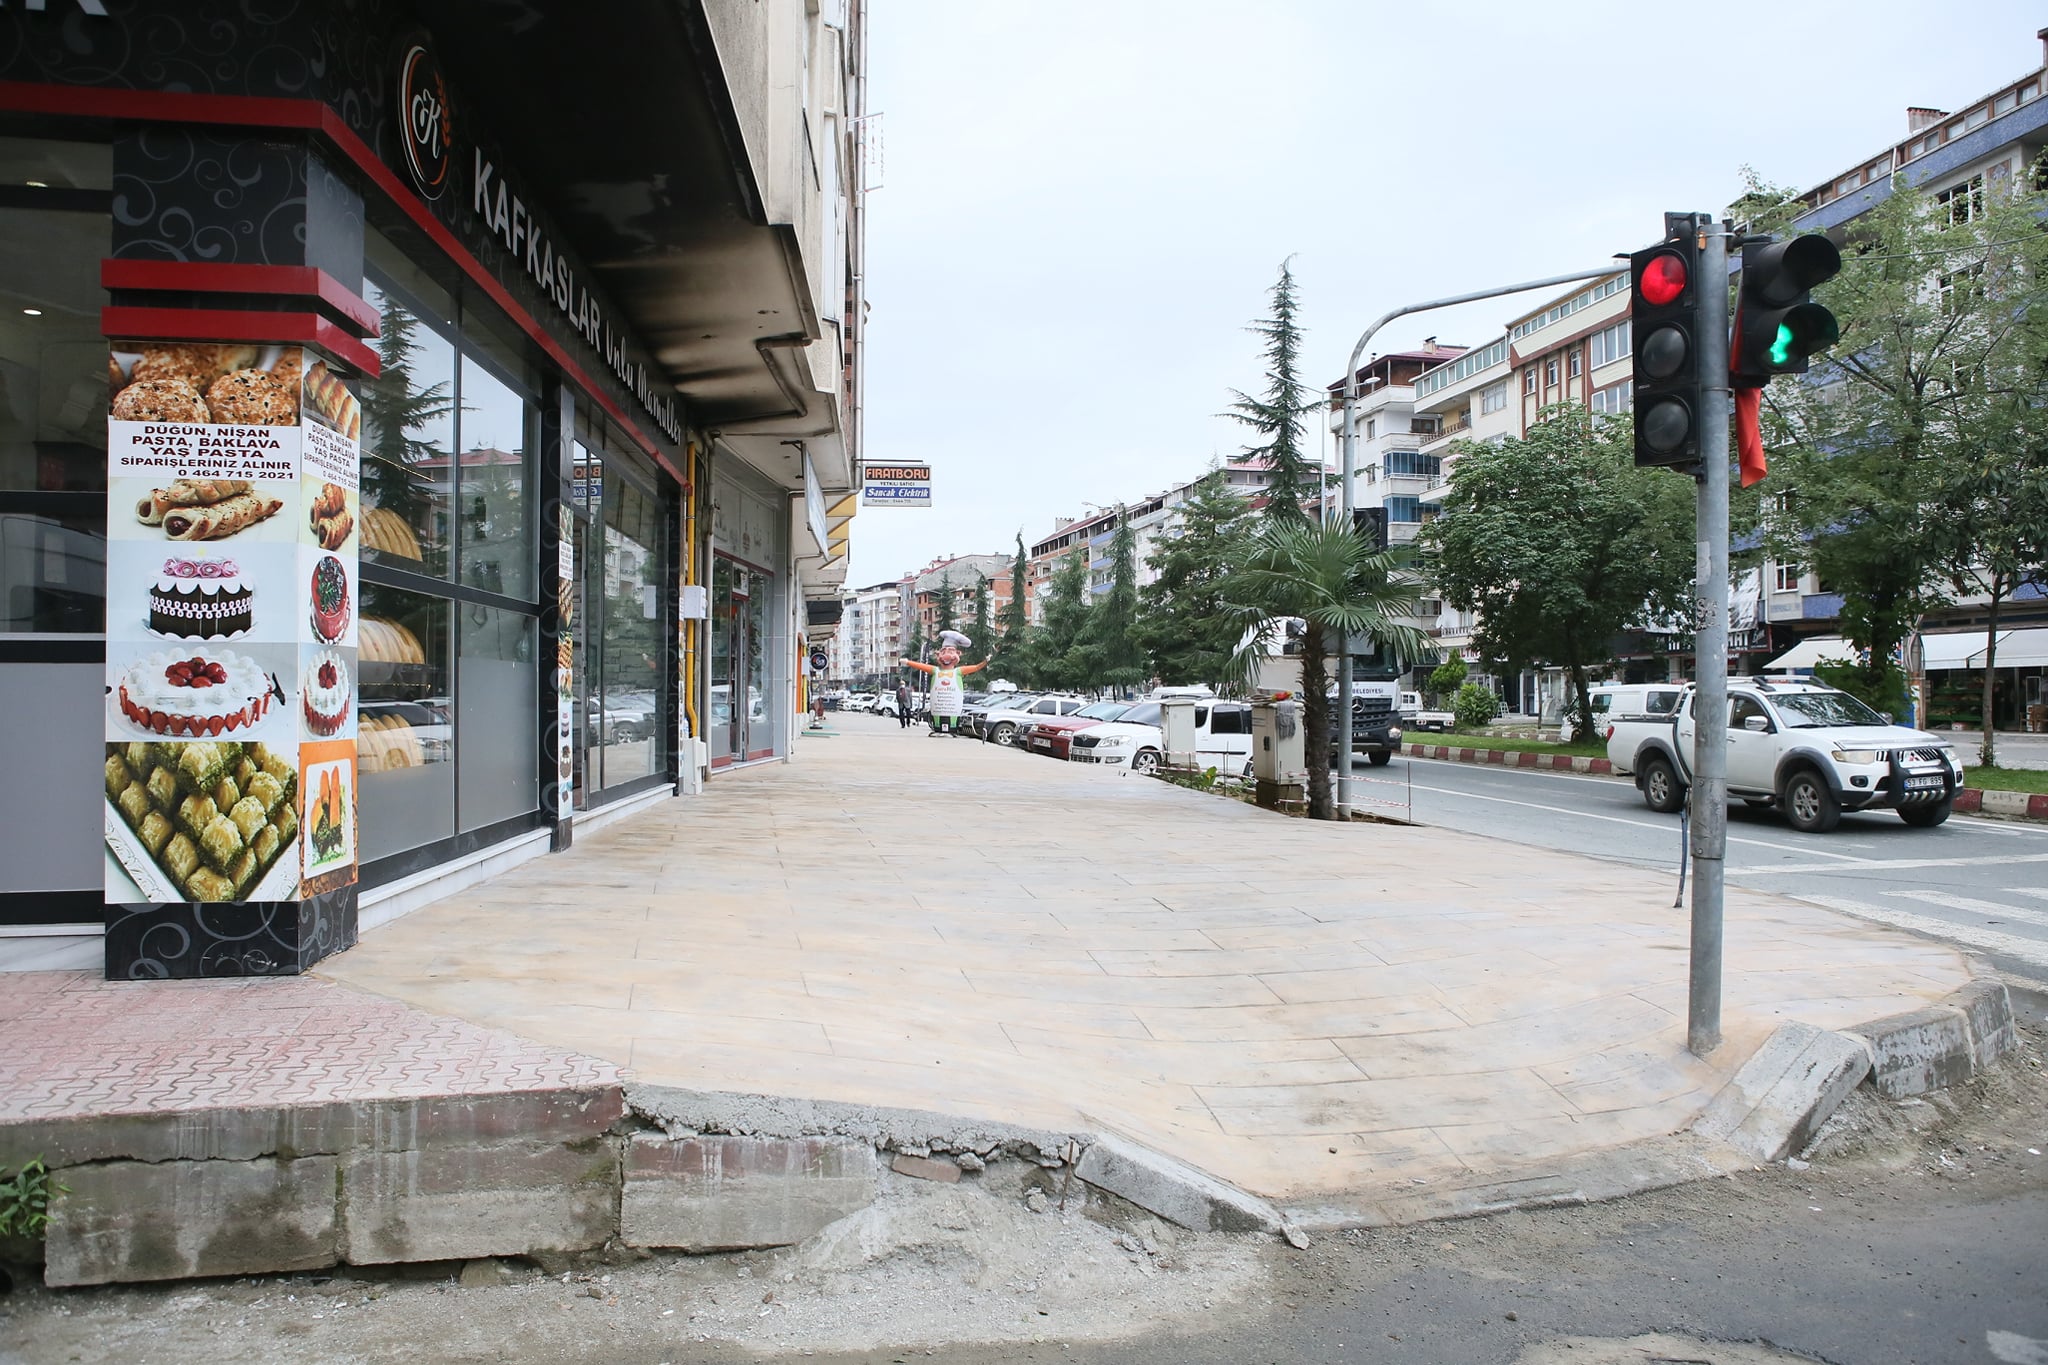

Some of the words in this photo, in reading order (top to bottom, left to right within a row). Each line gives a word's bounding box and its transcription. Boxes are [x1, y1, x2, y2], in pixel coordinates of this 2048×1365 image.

[474, 145, 601, 353] KAFKASLAR
[606, 319, 634, 391] Unlu
[144, 424, 212, 437] DÜĞÜN,
[217, 426, 270, 438] NİŞAN
[132, 435, 193, 448] PASTA,
[199, 438, 281, 449] BAKLAVA
[150, 447, 191, 458] YAŞ
[198, 449, 265, 459] PASTA
[120, 455, 238, 468] SİPARİŞLERİNİZ
[242, 461, 292, 470] ALINIR
[178, 469, 187, 477] 0
[258, 472, 294, 480] 2021
[867, 487, 896, 497] Sancak
[898, 488, 929, 498] Elektrik
